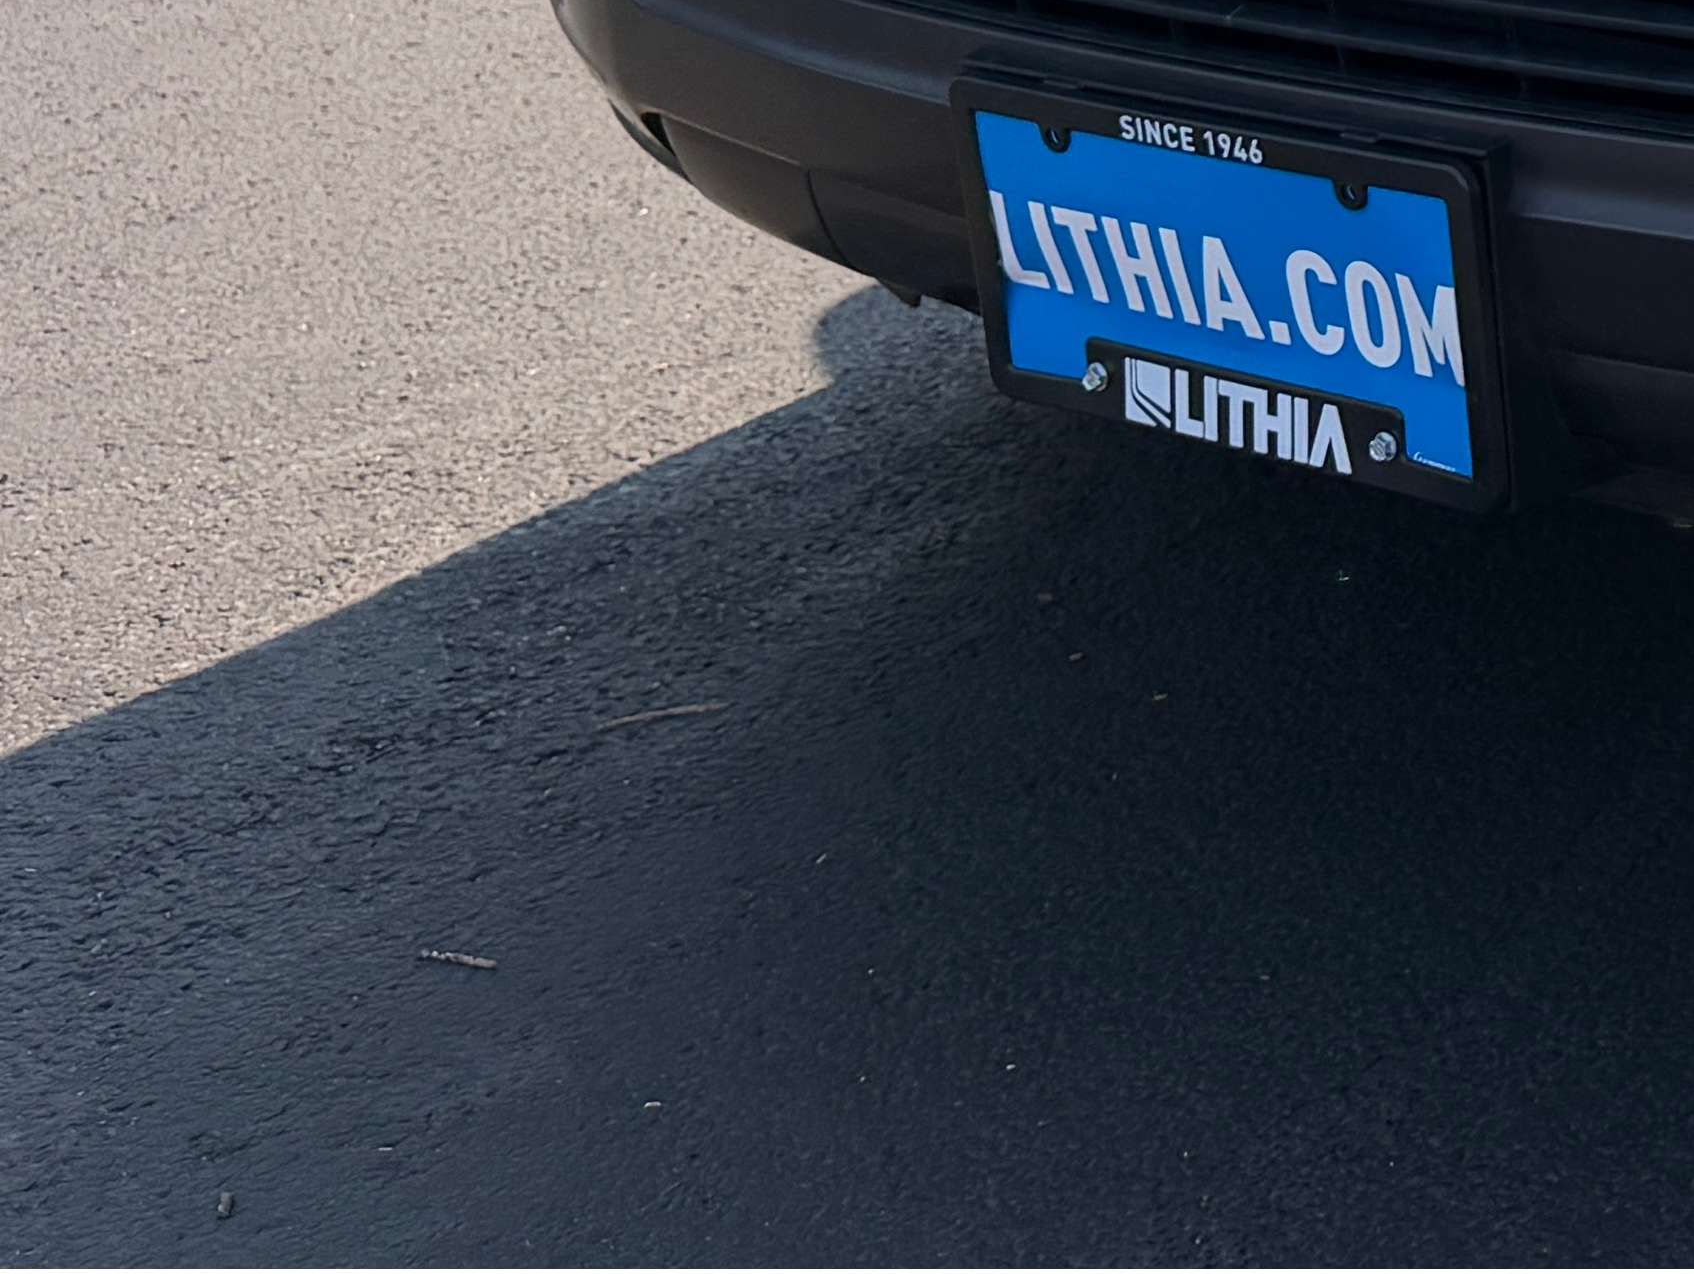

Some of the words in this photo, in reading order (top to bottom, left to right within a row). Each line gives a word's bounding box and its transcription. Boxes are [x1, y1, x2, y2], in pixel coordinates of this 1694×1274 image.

[1119, 115, 1196, 152] SINCE
[1203, 130, 1263, 164] 1946
[989, 189, 1466, 387] LITHIA.COM
[1173, 368, 1352, 475] LITHIA
